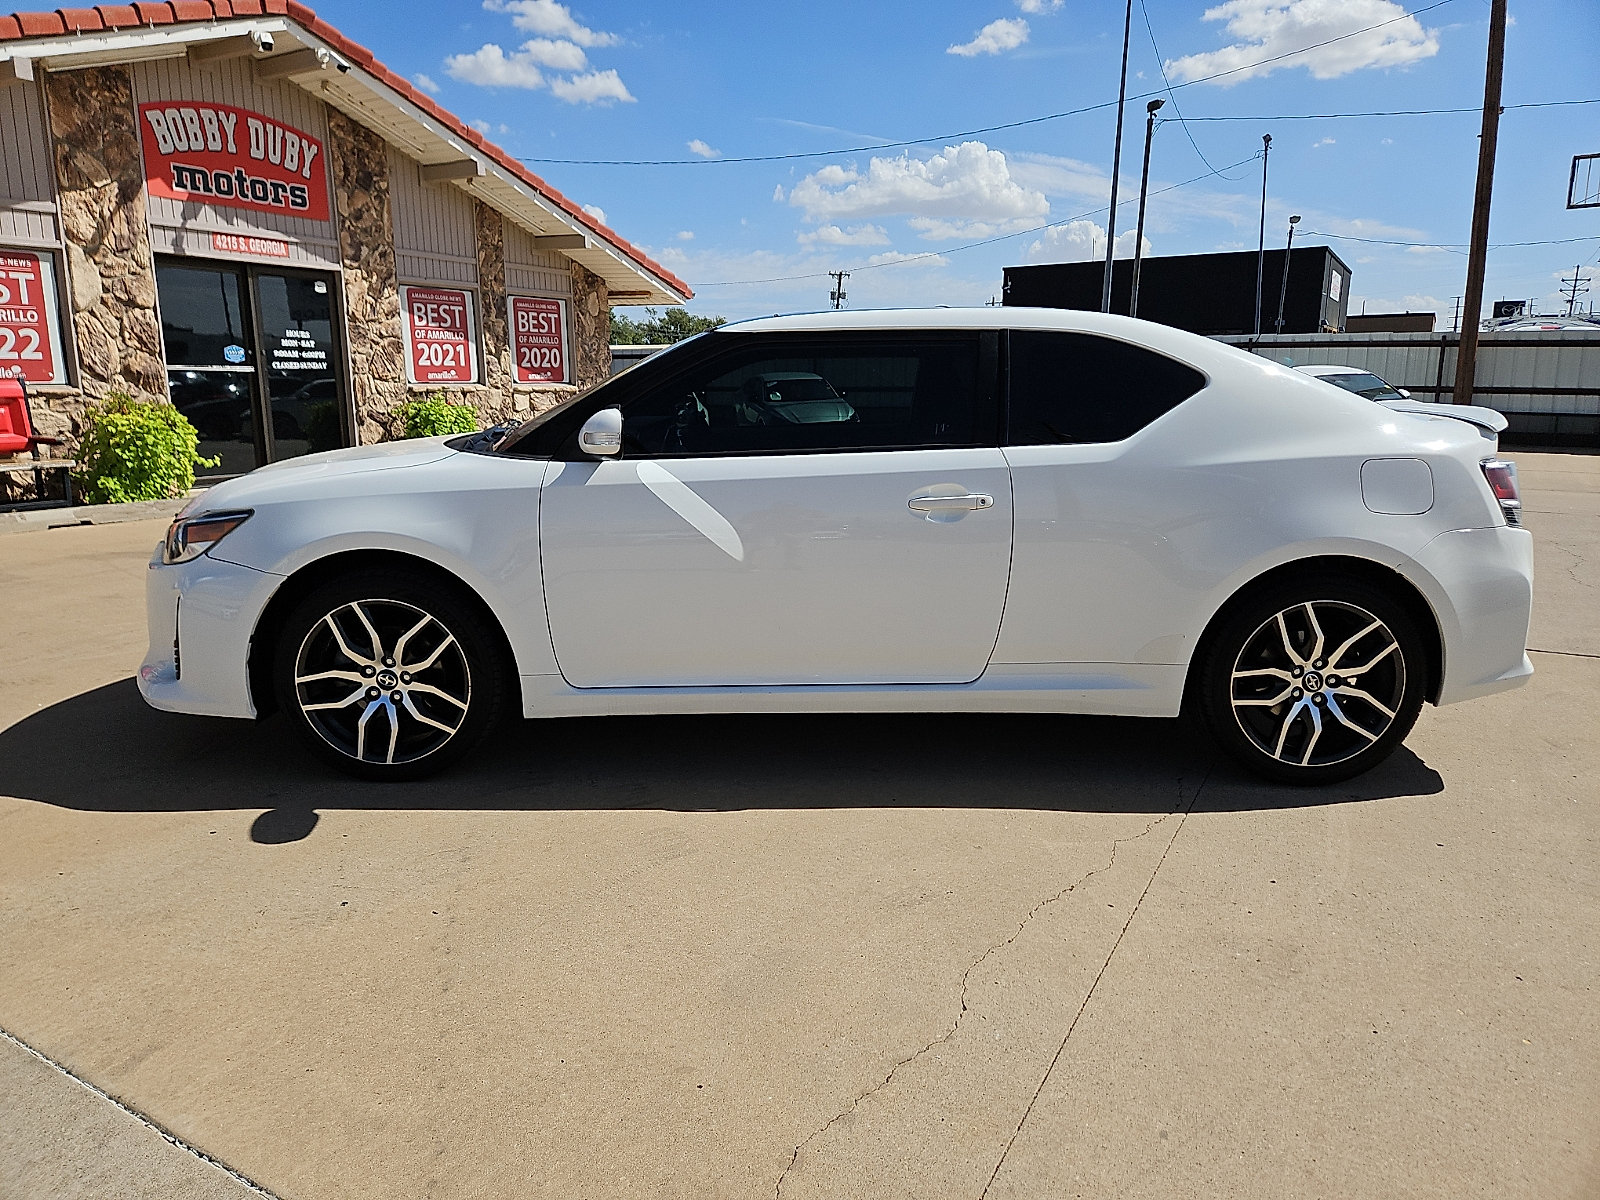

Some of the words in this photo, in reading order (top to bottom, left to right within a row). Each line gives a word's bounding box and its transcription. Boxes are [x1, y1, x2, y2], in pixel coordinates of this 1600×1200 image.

[145, 108, 237, 155] BOBBY
[248, 117, 318, 179] DUBY
[170, 162, 309, 211] motors
[216, 234, 238, 249] 4215
[238, 236, 248, 251] S.
[249, 238, 287, 256] GEORGIA
[413, 302, 463, 328] BEST
[518, 311, 558, 334] BEST
[415, 329, 426, 339] OF
[427, 330, 464, 340] AMARILLO
[519, 335, 528, 343] OF
[529, 336, 559, 345] AMARILLO
[272, 361, 300, 370] CLOSED
[300, 361, 328, 370] SUNDAY
[417, 342, 466, 367] 2021
[520, 347, 560, 368] 2020
